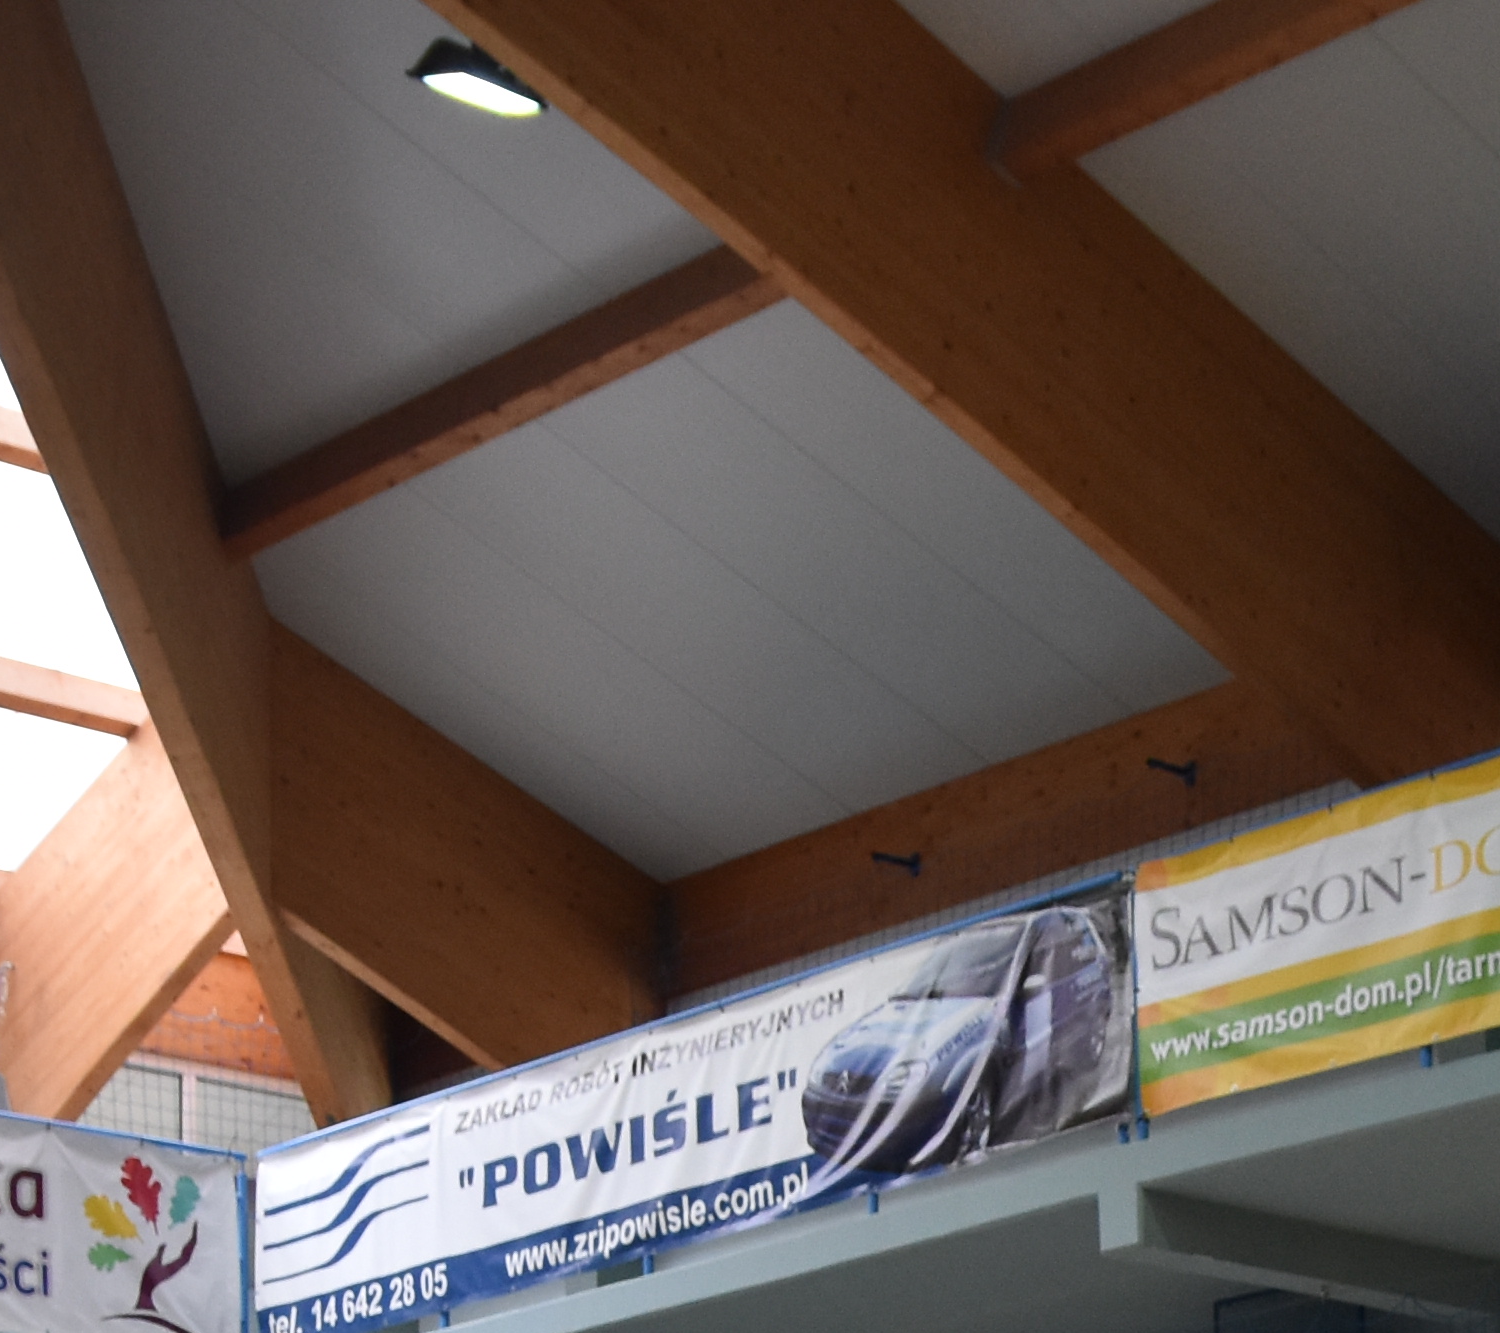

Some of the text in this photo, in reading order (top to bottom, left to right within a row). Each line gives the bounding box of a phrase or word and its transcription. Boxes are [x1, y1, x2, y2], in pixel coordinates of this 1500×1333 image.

[454, 989, 845, 1135] ZAKŁAD ROBÓT INŻYNIERYJNYCH
[504, 1160, 809, 1278] www.zripowisle.com.pl
[311, 1296, 338, 1332] 14
[342, 1282, 383, 1323] 642
[389, 1273, 416, 1311] 28
[420, 1262, 448, 1300] 05
